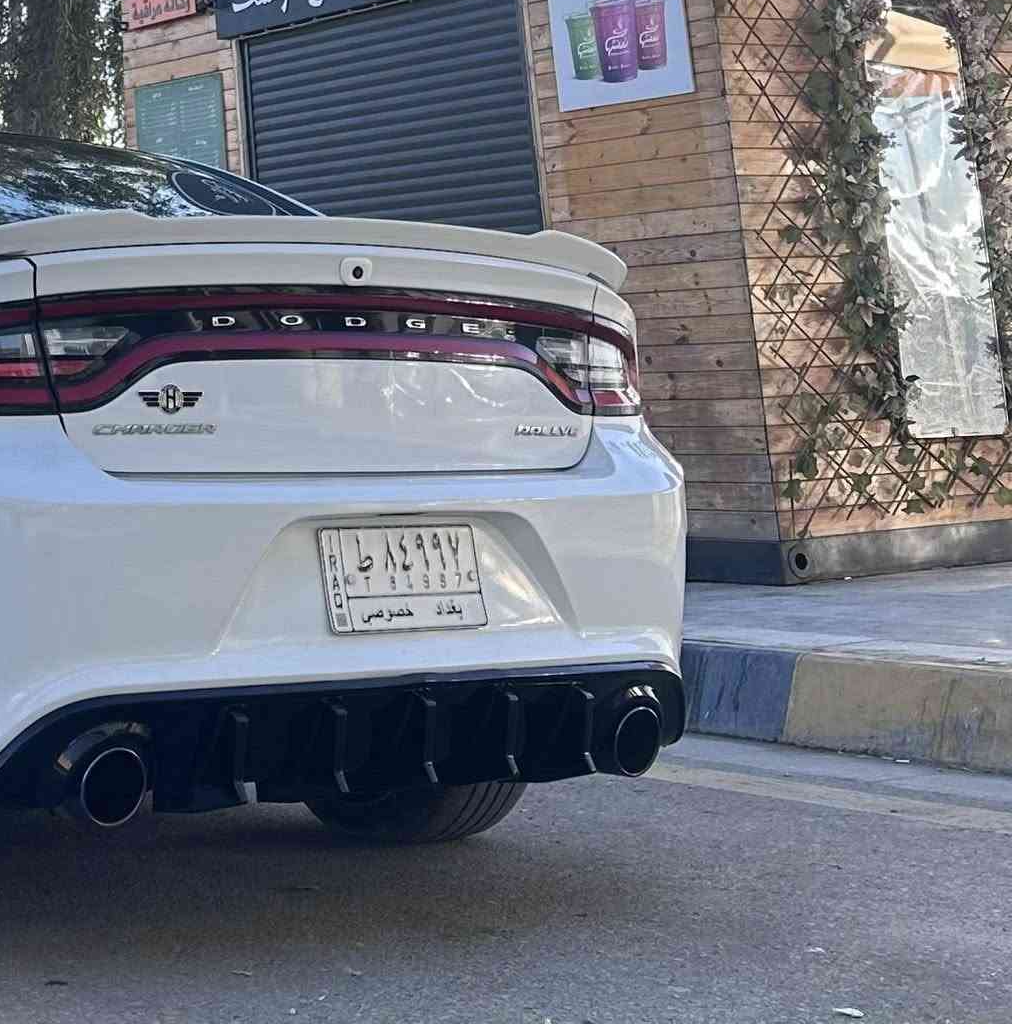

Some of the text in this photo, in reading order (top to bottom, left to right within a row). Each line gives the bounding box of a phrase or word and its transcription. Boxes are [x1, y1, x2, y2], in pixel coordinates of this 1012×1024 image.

[210, 314, 481, 335] DODGE
[92, 423, 218, 436] CHARGER
[328, 535, 343, 609] IRAQ
[361, 599, 463, 626] بغداد خصوصي
